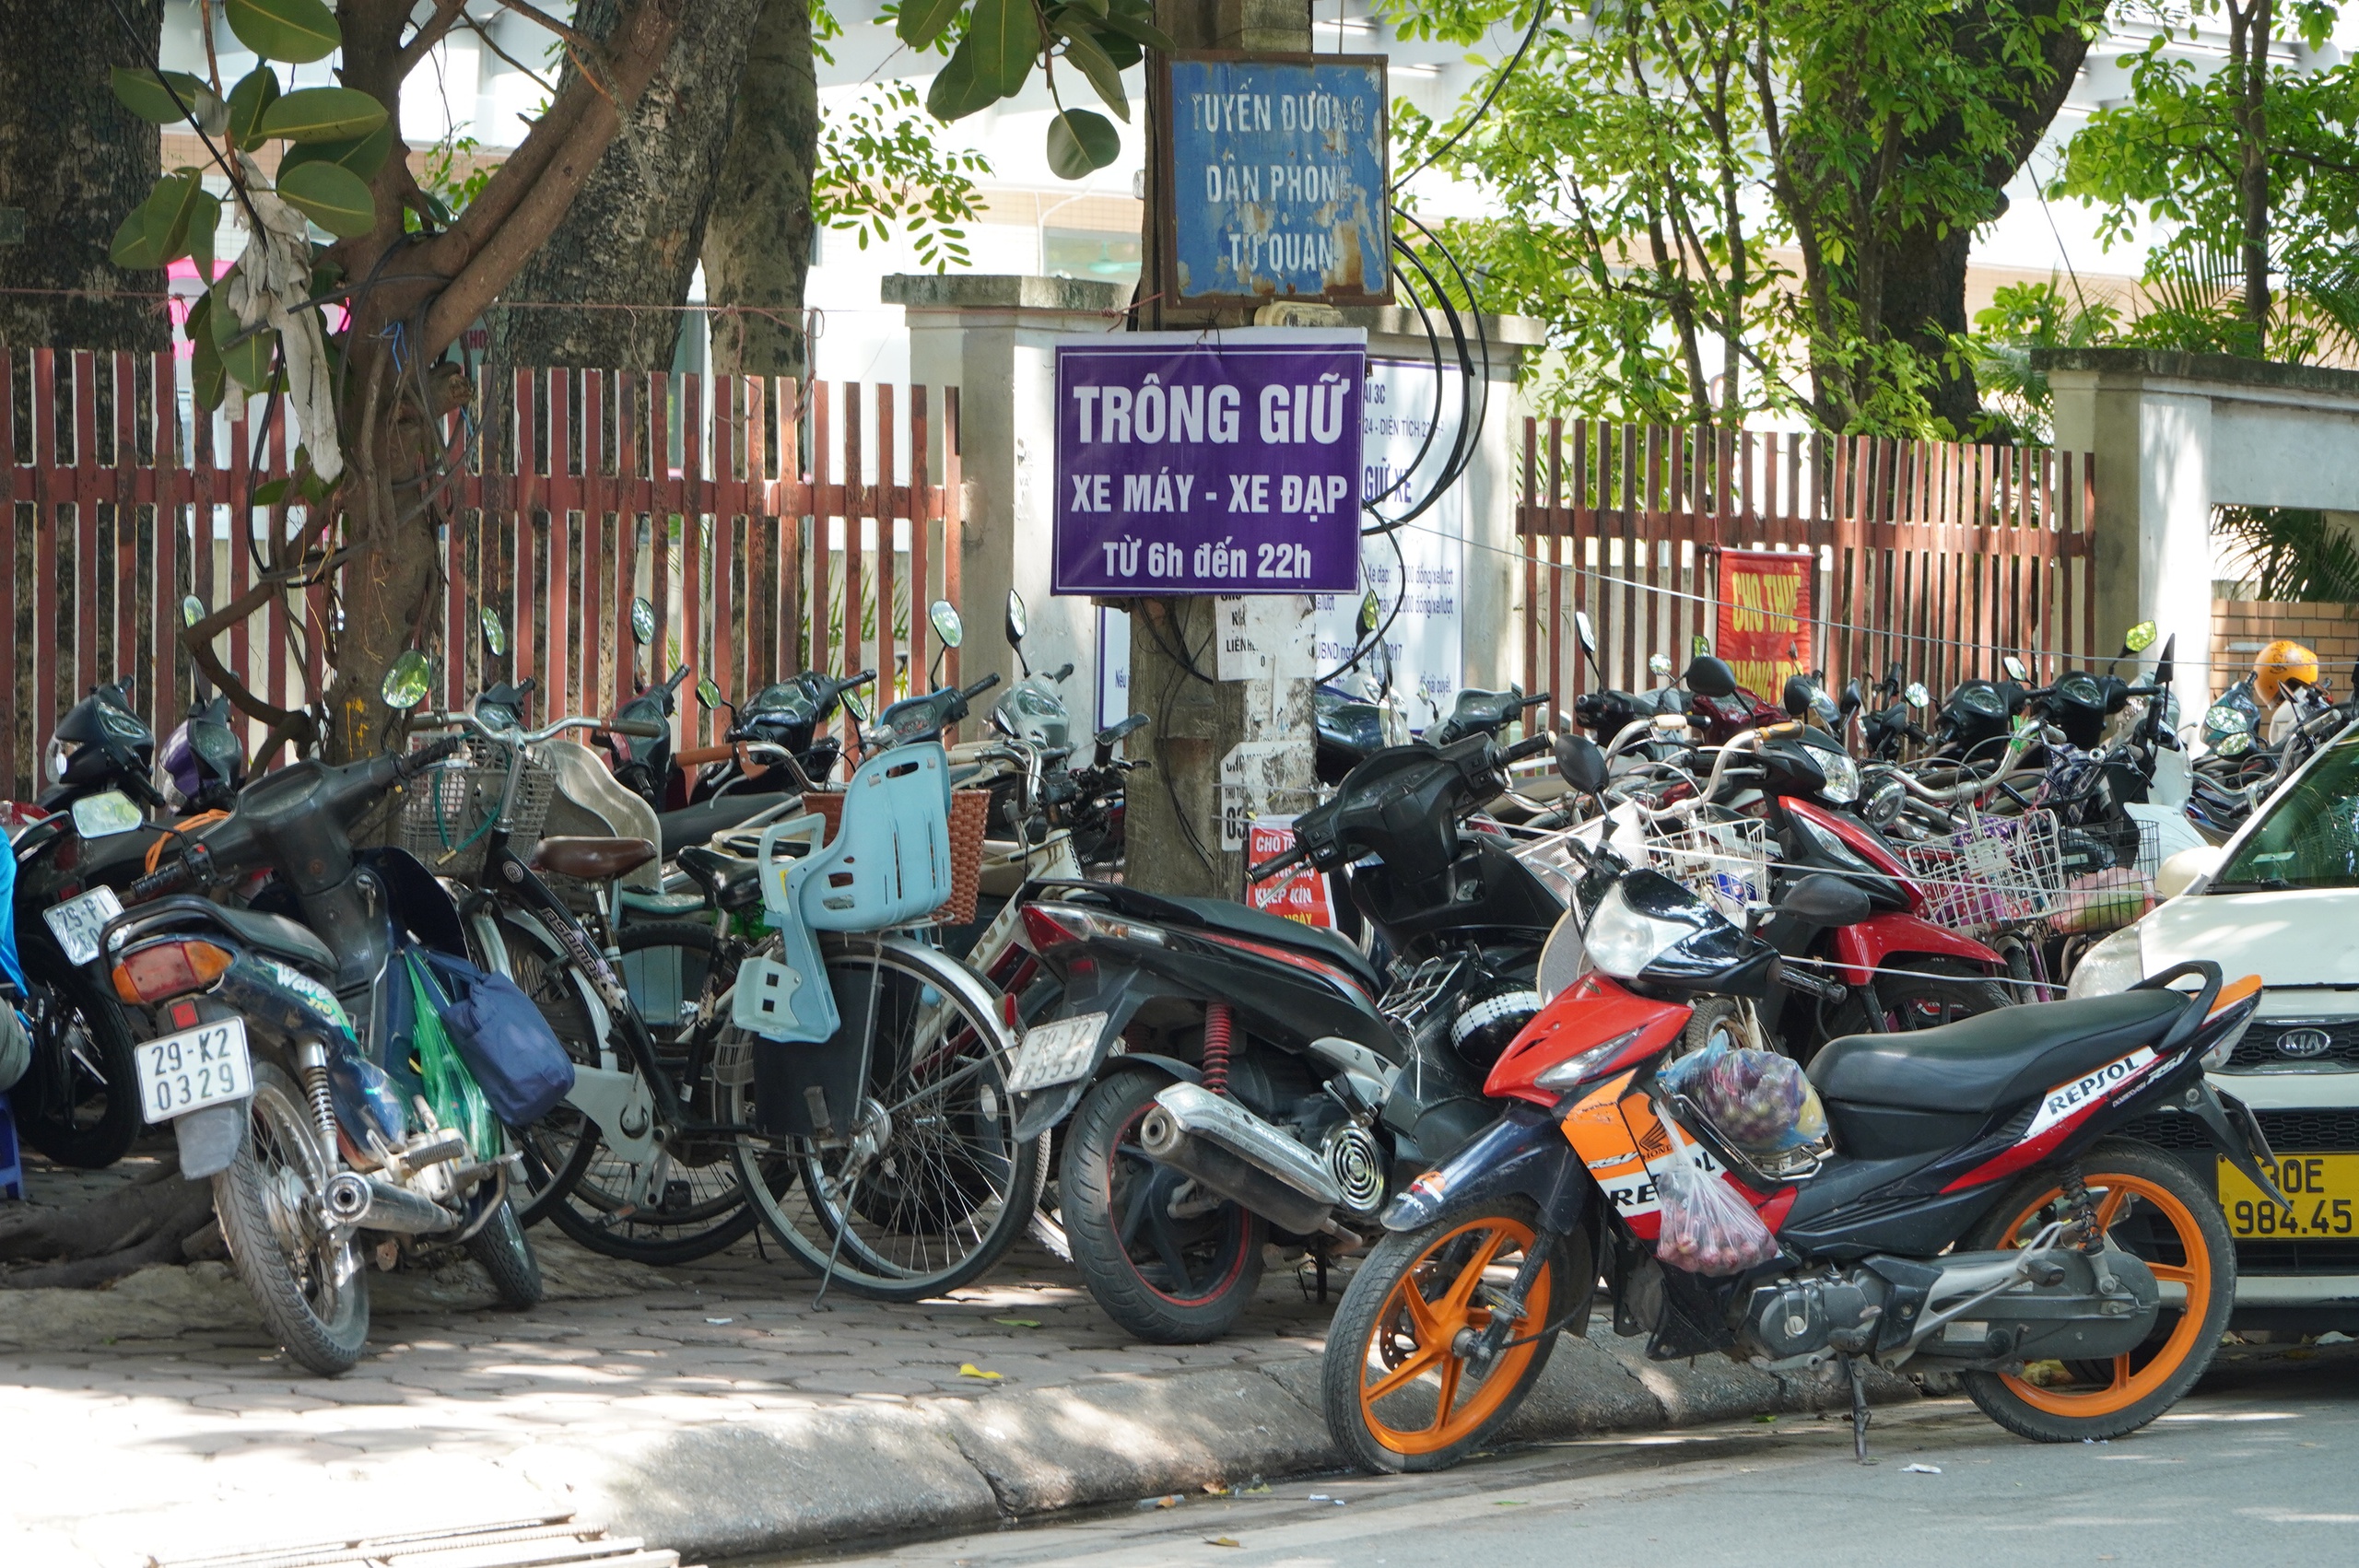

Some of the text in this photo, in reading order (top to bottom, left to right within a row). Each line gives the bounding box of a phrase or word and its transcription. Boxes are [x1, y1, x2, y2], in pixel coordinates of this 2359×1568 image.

[1191, 77, 1365, 134] TUYẾN ĐƯỜNG
[1205, 153, 1353, 203] DÂN PHÒNG
[1073, 372, 1351, 444] TRÔNG GIỮ
[1379, 415, 1399, 440] DIỆN
[1401, 415, 1420, 438] TÍCH
[1071, 474, 1111, 512] XE
[1123, 466, 1194, 512] MÁY
[1227, 474, 1270, 513] XE
[1281, 474, 1348, 522] ĐẠP
[1394, 467, 1412, 503] XE
[1103, 534, 1311, 579] TỪ 6h đến 22h
[1732, 562, 1802, 634] CHO THUÊ
[1226, 636, 1247, 653] LIÊN
[1725, 645, 1773, 704] HÒNG
[1256, 836, 1281, 852] CHO
[276, 962, 332, 1001] Wave
[151, 1027, 231, 1077] 29-K2
[2285, 1034, 2321, 1052] KIA
[156, 1062, 236, 1112] 0329
[2047, 1056, 2140, 1117] REPSOL
[2260, 1158, 2325, 1194] 30E
[2236, 1199, 2353, 1235] 984.45
